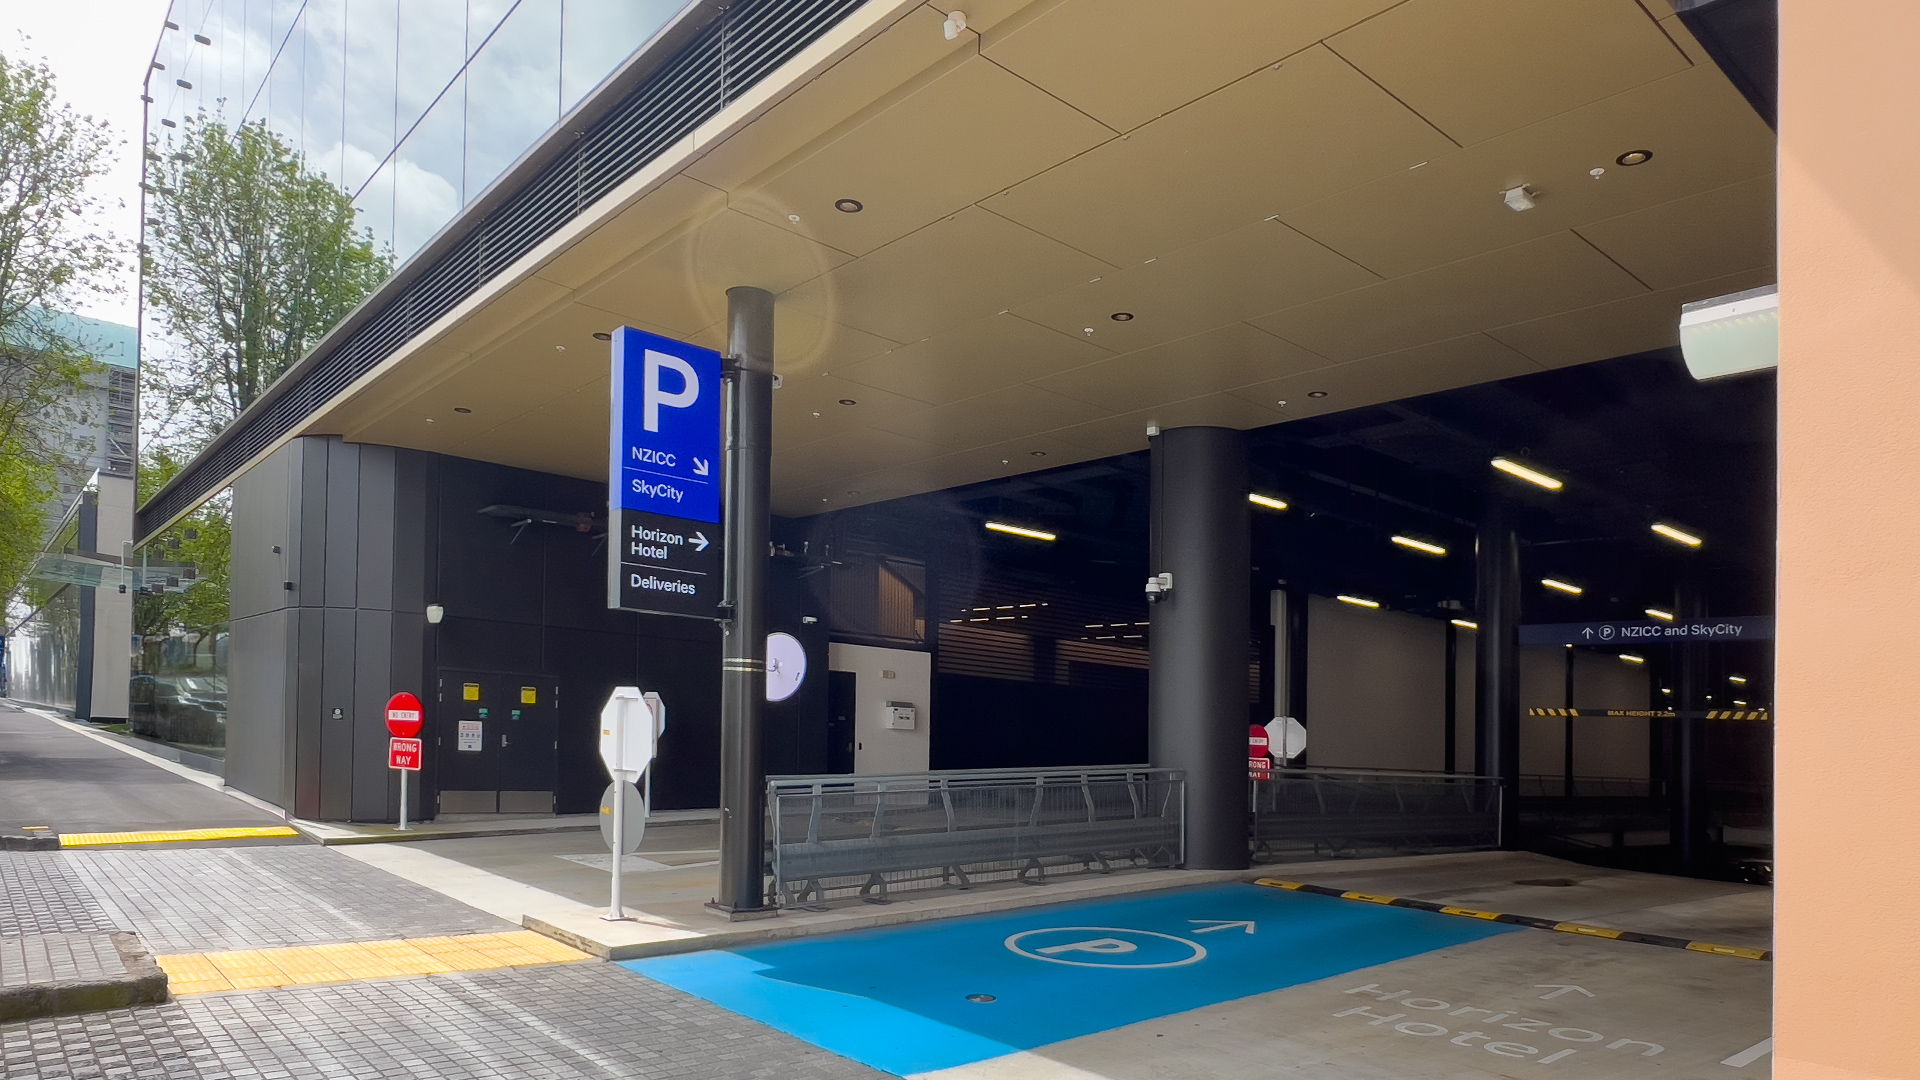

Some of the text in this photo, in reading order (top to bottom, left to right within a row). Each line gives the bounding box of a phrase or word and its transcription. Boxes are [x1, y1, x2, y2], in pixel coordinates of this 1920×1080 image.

[643, 348, 700, 433] P
[632, 446, 677, 467] NZICC
[632, 478, 684, 503] SkyCity
[631, 524, 683, 546] Horizon
[631, 541, 668, 559] Hotel
[630, 573, 697, 595] Deliveries
[1603, 623, 1743, 638] P NZICC and SkyCity
[392, 711, 415, 719] NO ENTRY
[1626, 710, 1656, 718] HEIGHT
[393, 742, 417, 753] WRONG
[396, 755, 412, 765] WAY
[1035, 937, 1138, 954] P
[1344, 983, 1665, 1057] Horizon
[1332, 1005, 1577, 1065] Hotel
